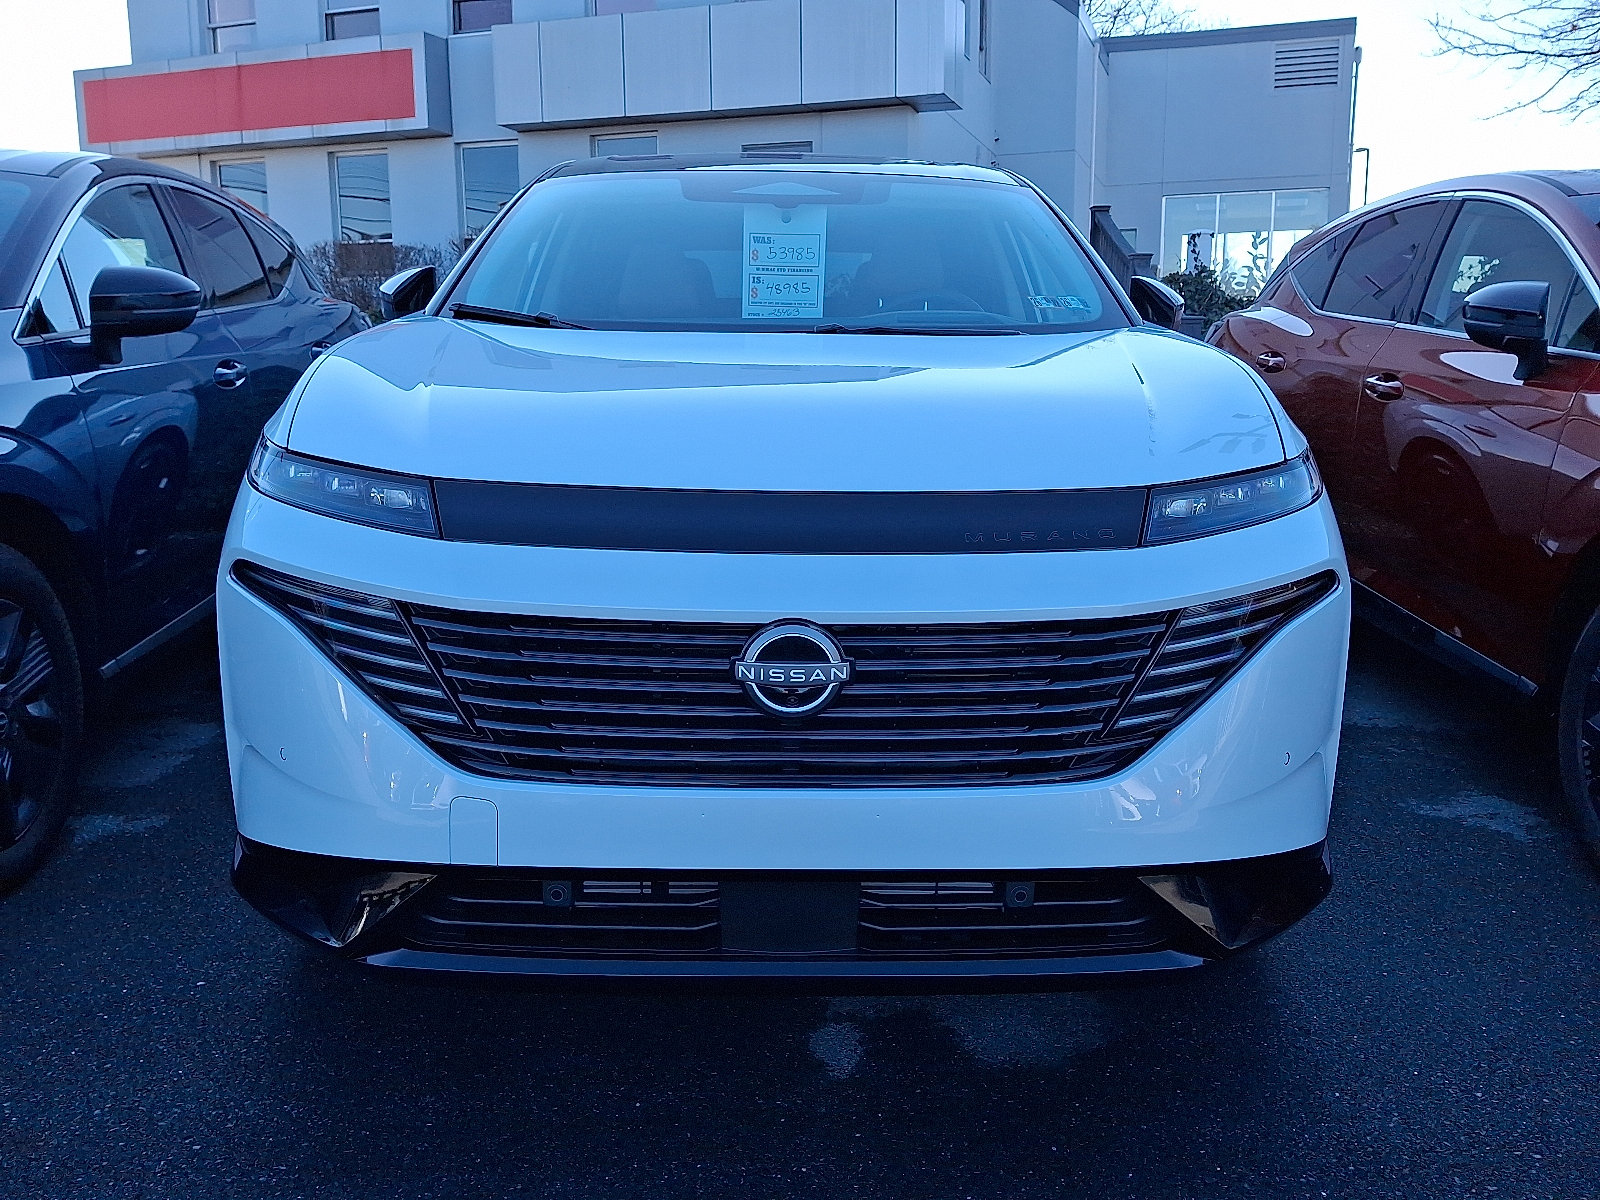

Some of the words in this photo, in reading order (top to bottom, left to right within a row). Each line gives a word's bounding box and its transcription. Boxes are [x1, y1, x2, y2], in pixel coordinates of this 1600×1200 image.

[752, 235, 776, 245] WAS:
[751, 248, 759, 263] $
[766, 246, 816, 261] 53985
[751, 276, 765, 285] IS:
[750, 285, 759, 300] $
[766, 281, 811, 297] 48985
[964, 528, 1117, 544] MURANO
[738, 665, 847, 682] NISSAN
